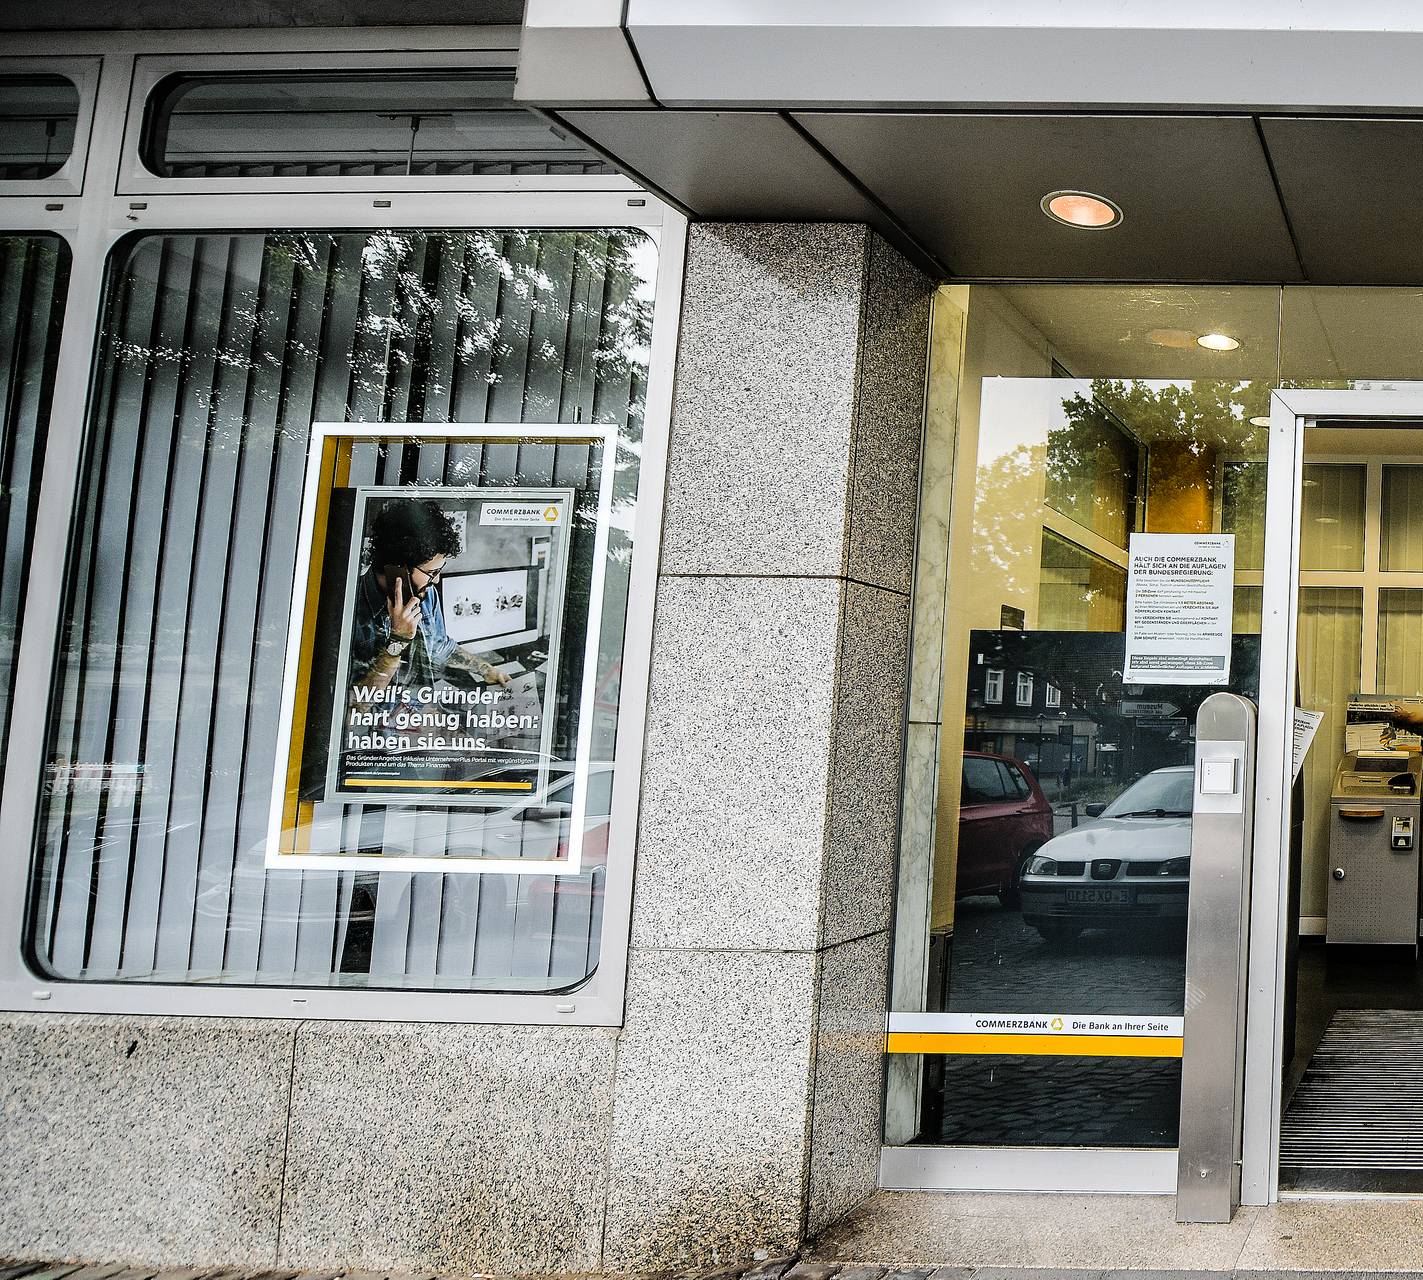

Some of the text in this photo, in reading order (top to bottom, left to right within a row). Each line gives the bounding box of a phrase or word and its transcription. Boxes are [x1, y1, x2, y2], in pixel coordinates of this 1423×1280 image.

[353, 686, 502, 704] Weil's Gründer
[350, 710, 538, 730] hart genug haben:
[348, 732, 491, 750] haben sie uns.
[976, 1020, 1048, 1029] COMMERZBANK
[1072, 1021, 1086, 1030] Die
[1089, 1021, 1110, 1030] Bank
[1125, 1023, 1145, 1031] Ihrer
[1147, 1023, 1169, 1031] Seite
